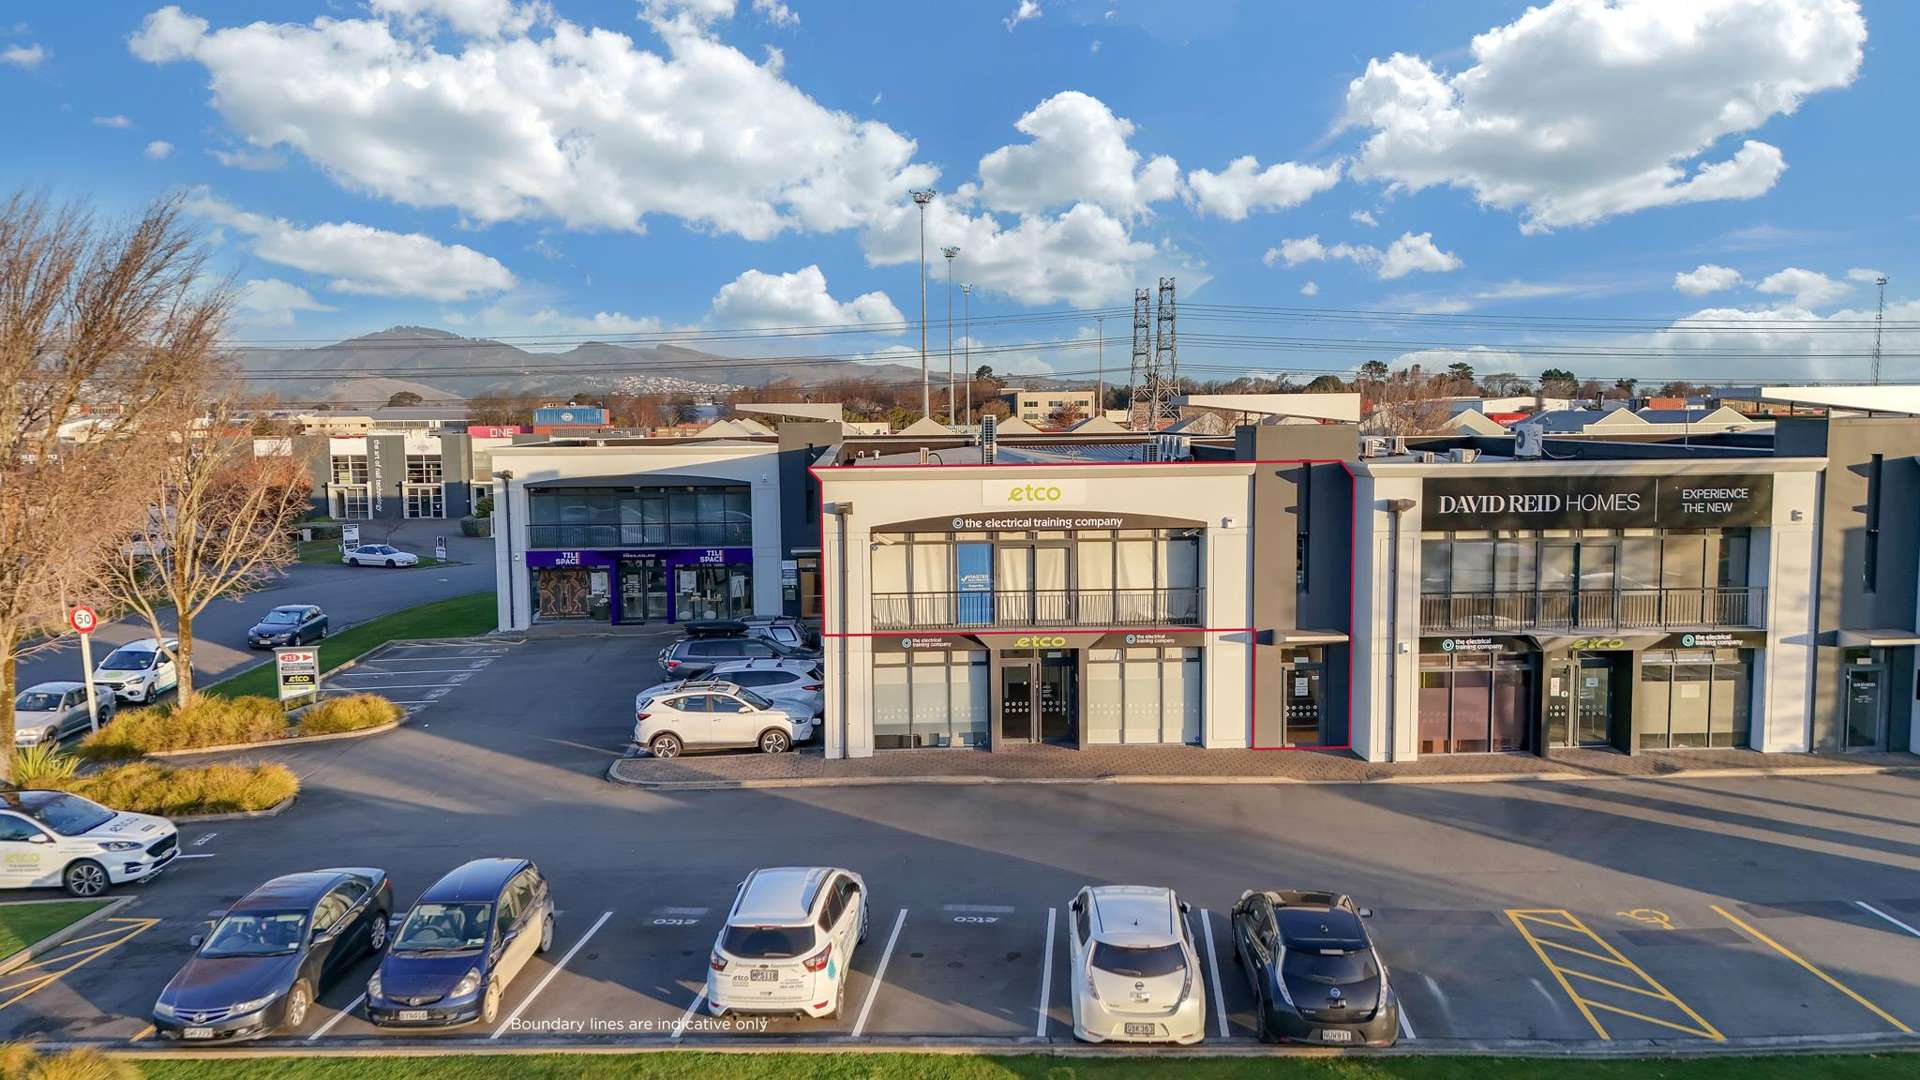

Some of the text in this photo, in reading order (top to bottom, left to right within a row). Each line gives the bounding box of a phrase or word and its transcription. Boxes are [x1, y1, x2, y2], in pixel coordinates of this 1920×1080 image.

[489, 428, 513, 438] ONE
[374, 460, 382, 468] of
[375, 479, 383, 512] technology
[1008, 484, 1061, 501] etco
[1682, 488, 1748, 499] EXPERIENCE
[1439, 493, 1640, 514] DAVID REID HOMES
[1682, 502, 1733, 513] THE NEW
[965, 517, 1123, 530] the electrical training company
[77, 614, 90, 624] 50
[1014, 635, 1066, 648] etco
[1569, 638, 1624, 649] etco
[288, 675, 310, 683] etco
